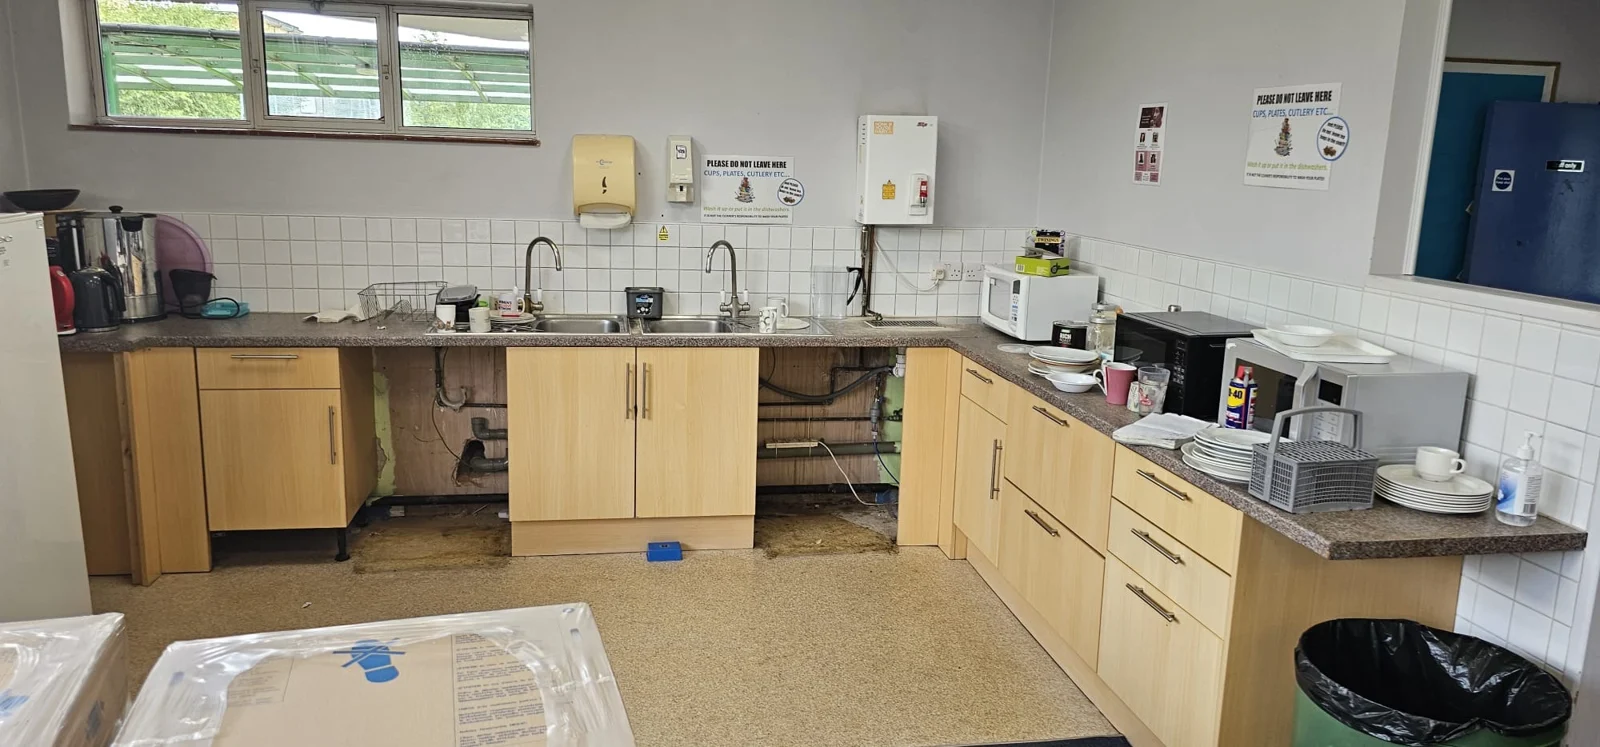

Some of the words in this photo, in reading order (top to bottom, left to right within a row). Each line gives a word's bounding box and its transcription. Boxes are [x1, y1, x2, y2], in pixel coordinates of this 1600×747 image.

[1257, 94, 1275, 105] PLEASE
[1276, 94, 1283, 104] DO
[1284, 93, 1295, 104] NOT
[1296, 92, 1313, 103] LEAVE
[1315, 90, 1332, 102] HERE
[1253, 110, 1266, 118] CUPS,
[1268, 109, 1287, 117] PLATES,
[1288, 108, 1315, 117] CUTLERY
